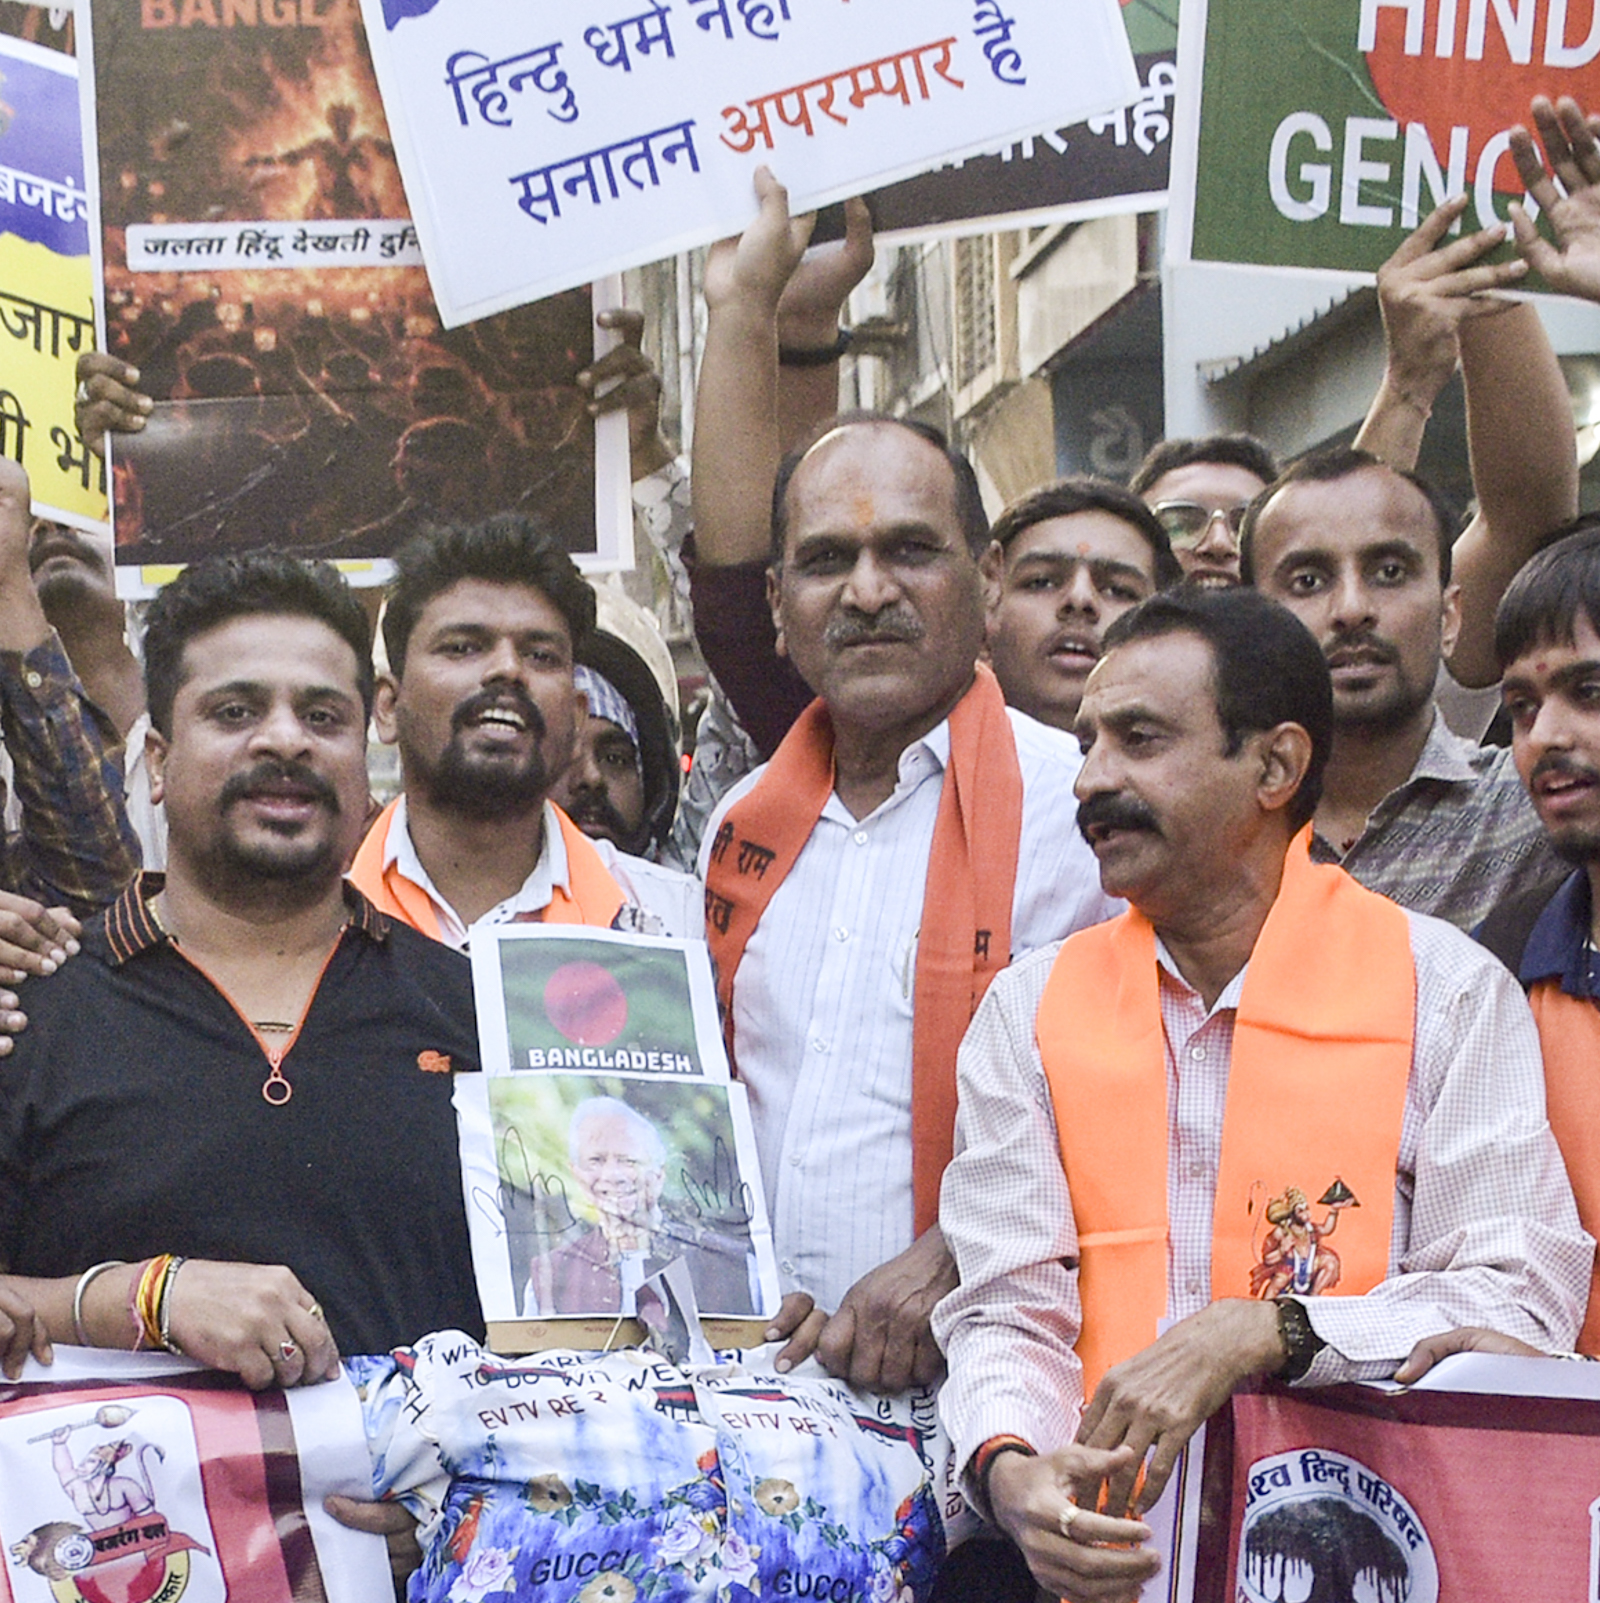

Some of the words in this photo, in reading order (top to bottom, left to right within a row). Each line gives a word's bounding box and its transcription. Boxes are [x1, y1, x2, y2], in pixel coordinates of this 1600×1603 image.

[445, 42, 579, 128] हिन्दु
[510, 119, 701, 226] सनातन
[719, 36, 965, 155] अपरम्पार
[143, 236, 227, 257] जलता
[236, 229, 284, 261] हिंदू
[291, 227, 370, 256] देखती
[737, 838, 777, 881] राम
[527, 1047, 694, 1074] BANGLADESH
[1298, 1451, 1354, 1498] हिन्दू
[1357, 1470, 1425, 1551] परिषद
[529, 1549, 632, 1588] GUCCI
[772, 1567, 858, 1603] GUCCI
